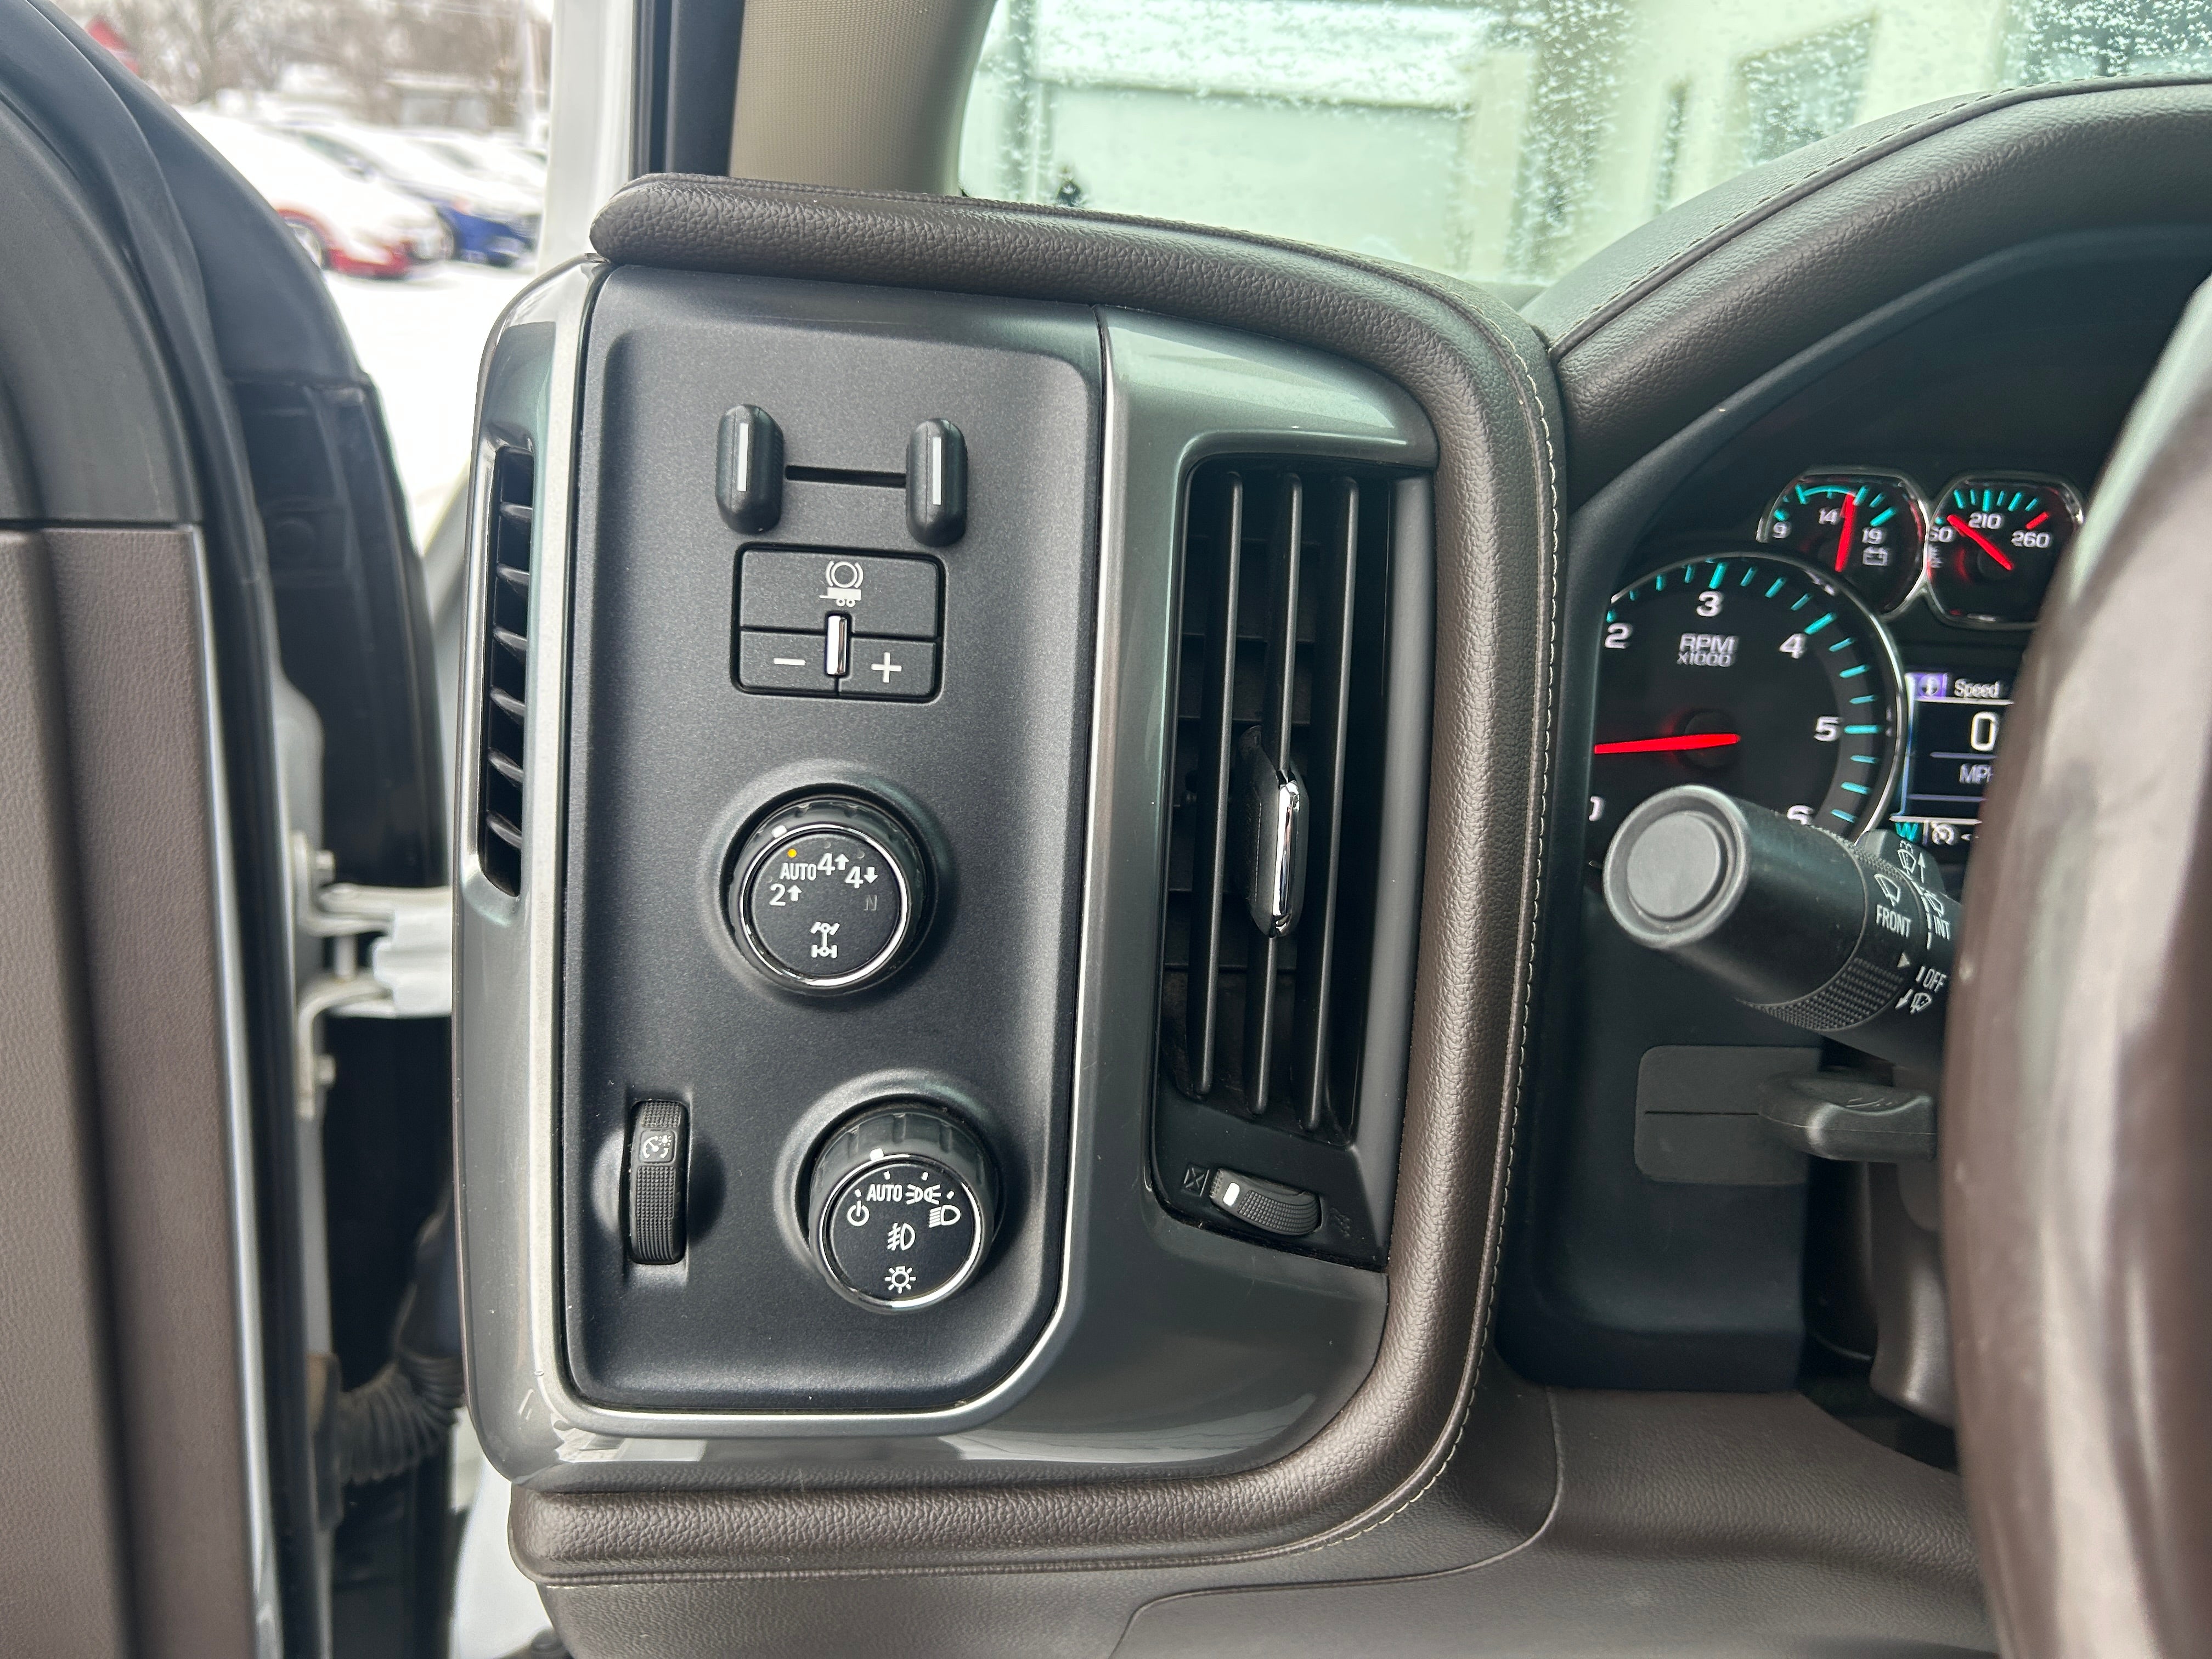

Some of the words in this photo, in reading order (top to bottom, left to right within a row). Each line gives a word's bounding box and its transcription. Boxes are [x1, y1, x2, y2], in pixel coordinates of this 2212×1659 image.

[1818, 507, 1838, 525] 14
[1968, 512, 2003, 529] 210
[1773, 521, 1790, 539] 9
[1862, 527, 1884, 545] 19
[2011, 529, 2051, 548] 260
[1696, 590, 1724, 617] 3
[1604, 622, 1633, 650] 2
[1679, 632, 1740, 654] RPM
[1779, 633, 1807, 659] 4
[1954, 678, 2001, 699] Speed
[1813, 715, 1840, 742] 5
[1970, 711, 2000, 752] 0
[779, 862, 817, 881] AUTO
[817, 852, 836, 876] 4
[844, 866, 864, 889] 4
[769, 883, 787, 906] 2
[864, 894, 878, 912] N
[1875, 904, 1912, 938] FRONT
[1933, 915, 1950, 941] INT
[1922, 968, 1948, 993] OFF
[866, 1183, 903, 1202] AUTO
